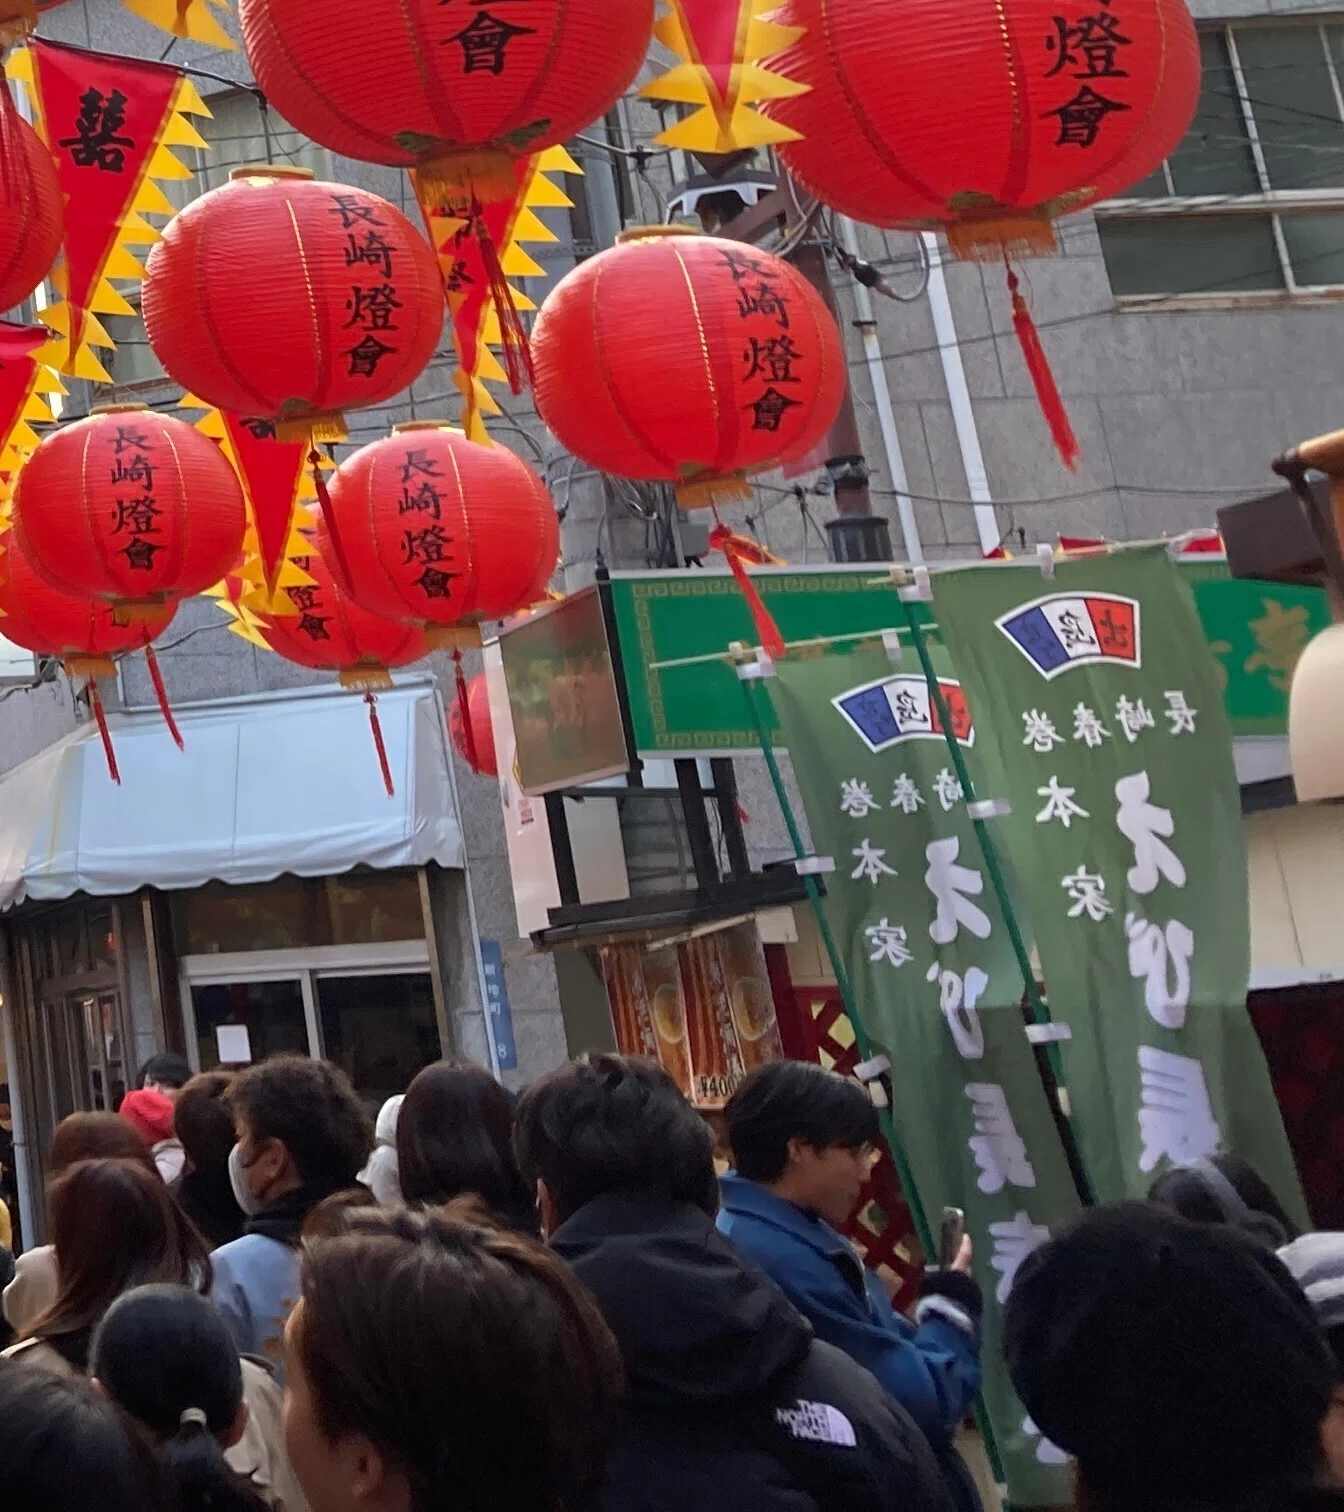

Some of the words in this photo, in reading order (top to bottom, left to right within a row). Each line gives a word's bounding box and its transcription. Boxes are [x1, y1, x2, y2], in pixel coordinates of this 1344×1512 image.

[59, 86, 134, 174] 囍
[331, 191, 405, 378] 長崎燈會
[717, 245, 803, 435] 長崎燈會
[111, 425, 166, 570] 長崎燈會
[397, 449, 463, 599] 長崎燈會
